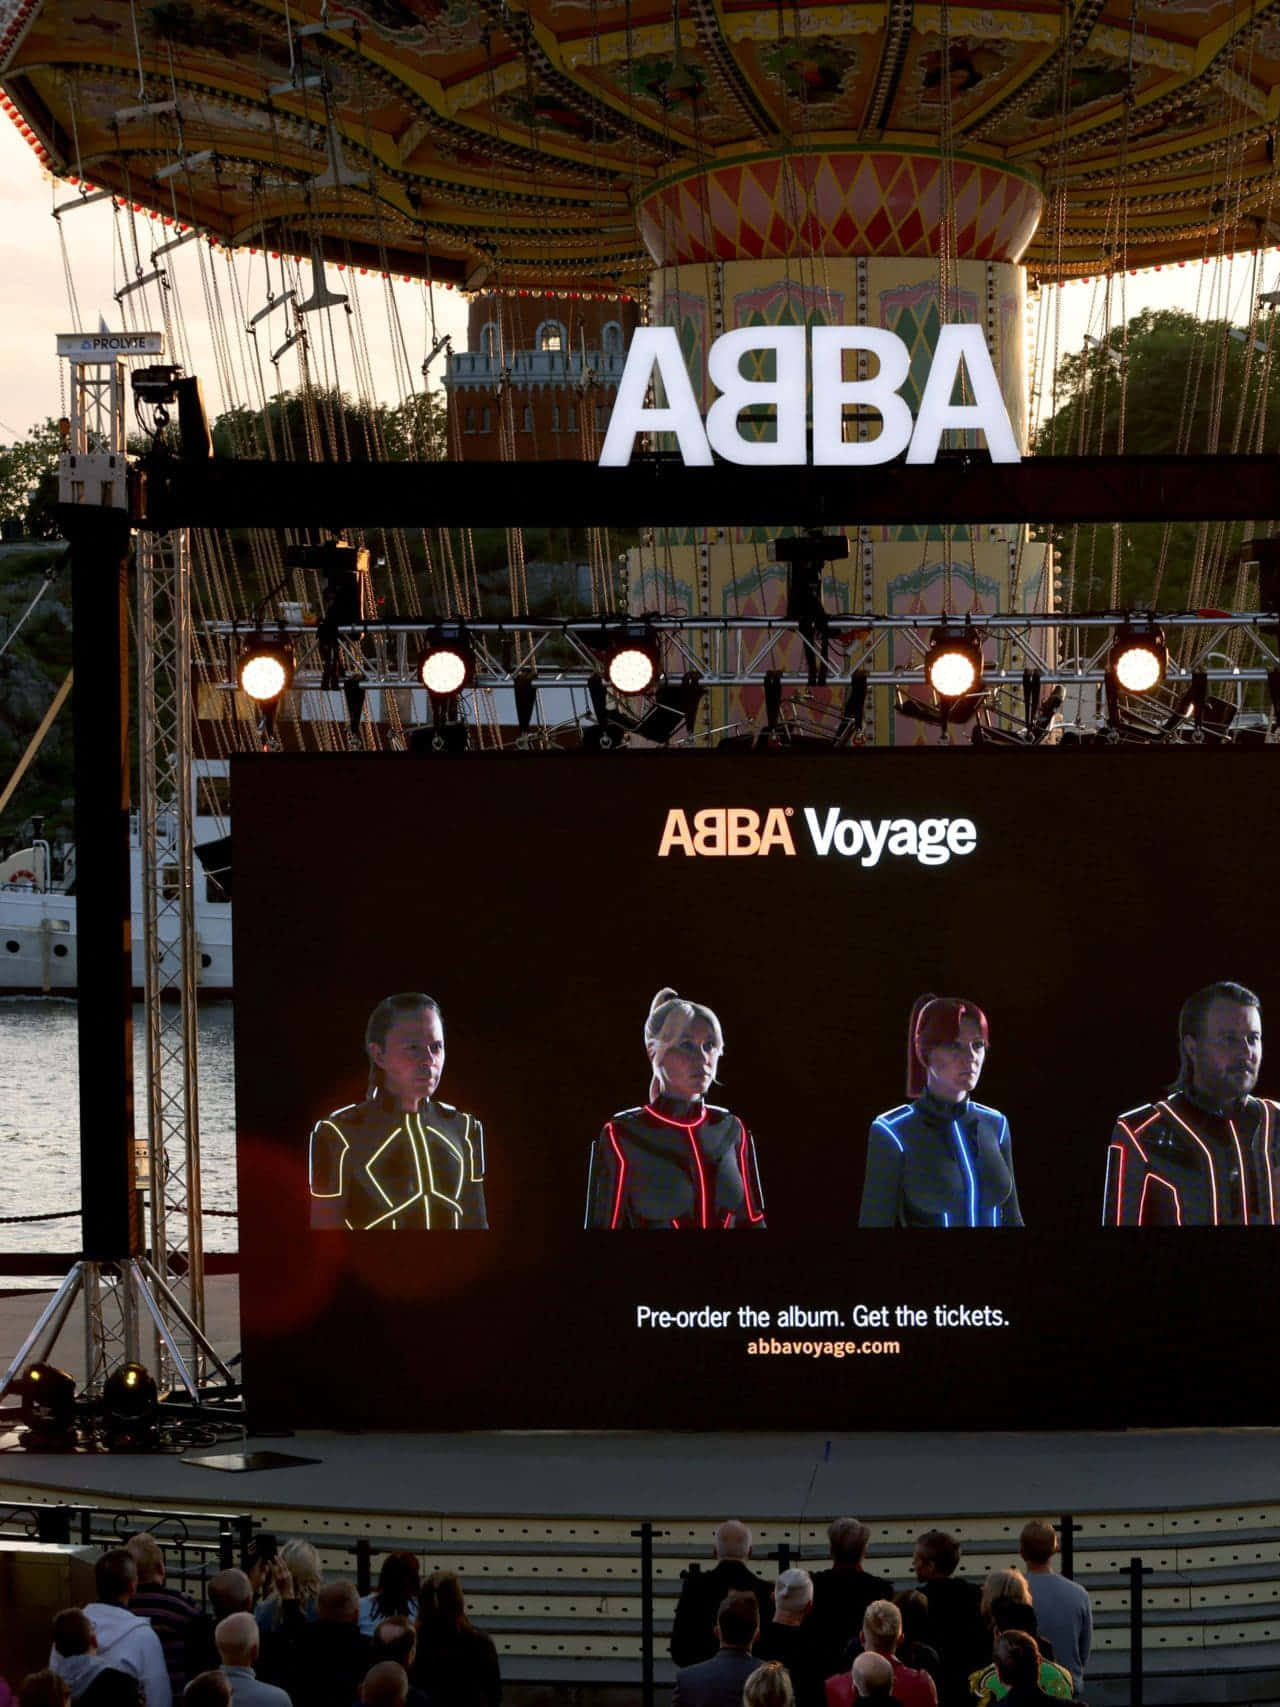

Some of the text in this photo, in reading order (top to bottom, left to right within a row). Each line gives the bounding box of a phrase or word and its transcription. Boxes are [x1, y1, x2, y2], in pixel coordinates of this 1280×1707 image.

[92, 336, 146, 350] PROLYTE
[598, 323, 1022, 467] ABBA
[803, 807, 977, 867] Voyage
[636, 1304, 1010, 1328] Pre-order the album. Get the tickets.
[747, 1337, 901, 1359] abbavoyage.com
